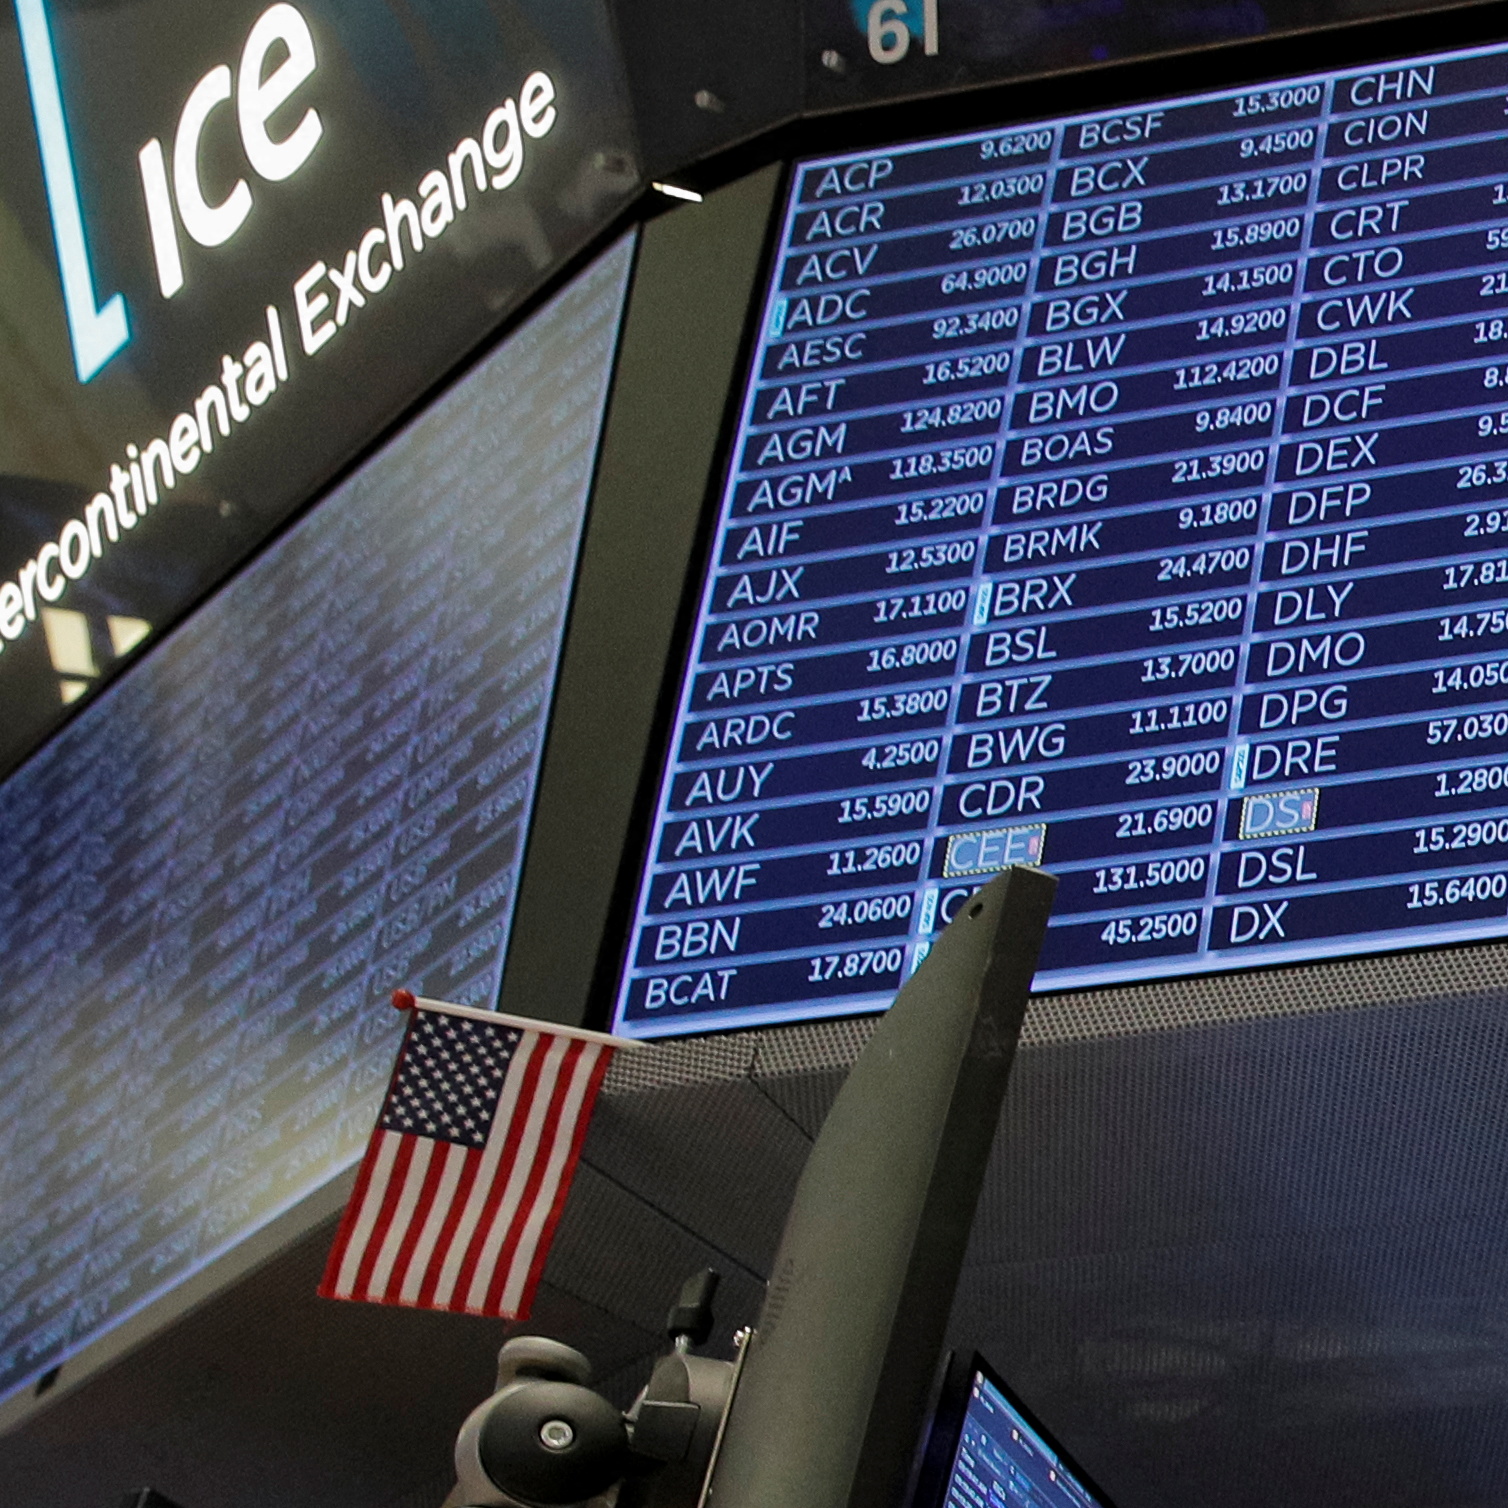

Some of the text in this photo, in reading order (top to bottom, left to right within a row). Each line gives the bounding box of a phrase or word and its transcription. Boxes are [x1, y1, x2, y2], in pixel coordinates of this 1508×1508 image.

[1343, 108, 1428, 146] CION
[1069, 127, 1314, 197] BCX 9.4500
[795, 217, 1035, 285] ACV 26.0700
[1053, 216, 1300, 286] BGH 15.8900
[1322, 246, 1403, 285] CTO
[0, 304, 288, 652] ercontinental
[292, 69, 557, 356] Exchange
[1027, 353, 1279, 423] BMO 112.4200
[1011, 448, 1264, 514] BRDG 21.3900
[1294, 431, 1379, 476] DEX
[735, 491, 984, 560] AIF 15.2200
[716, 588, 966, 652] AOMR 17.1100
[975, 647, 1235, 717] BTZ 13.7000
[1265, 630, 1365, 677] DMO
[695, 688, 948, 751] ARDC 15.3800
[1251, 734, 1340, 780] DRE
[1229, 873, 1507, 943] DX 15.6400
[643, 947, 902, 1009] BCAT 17.8700
